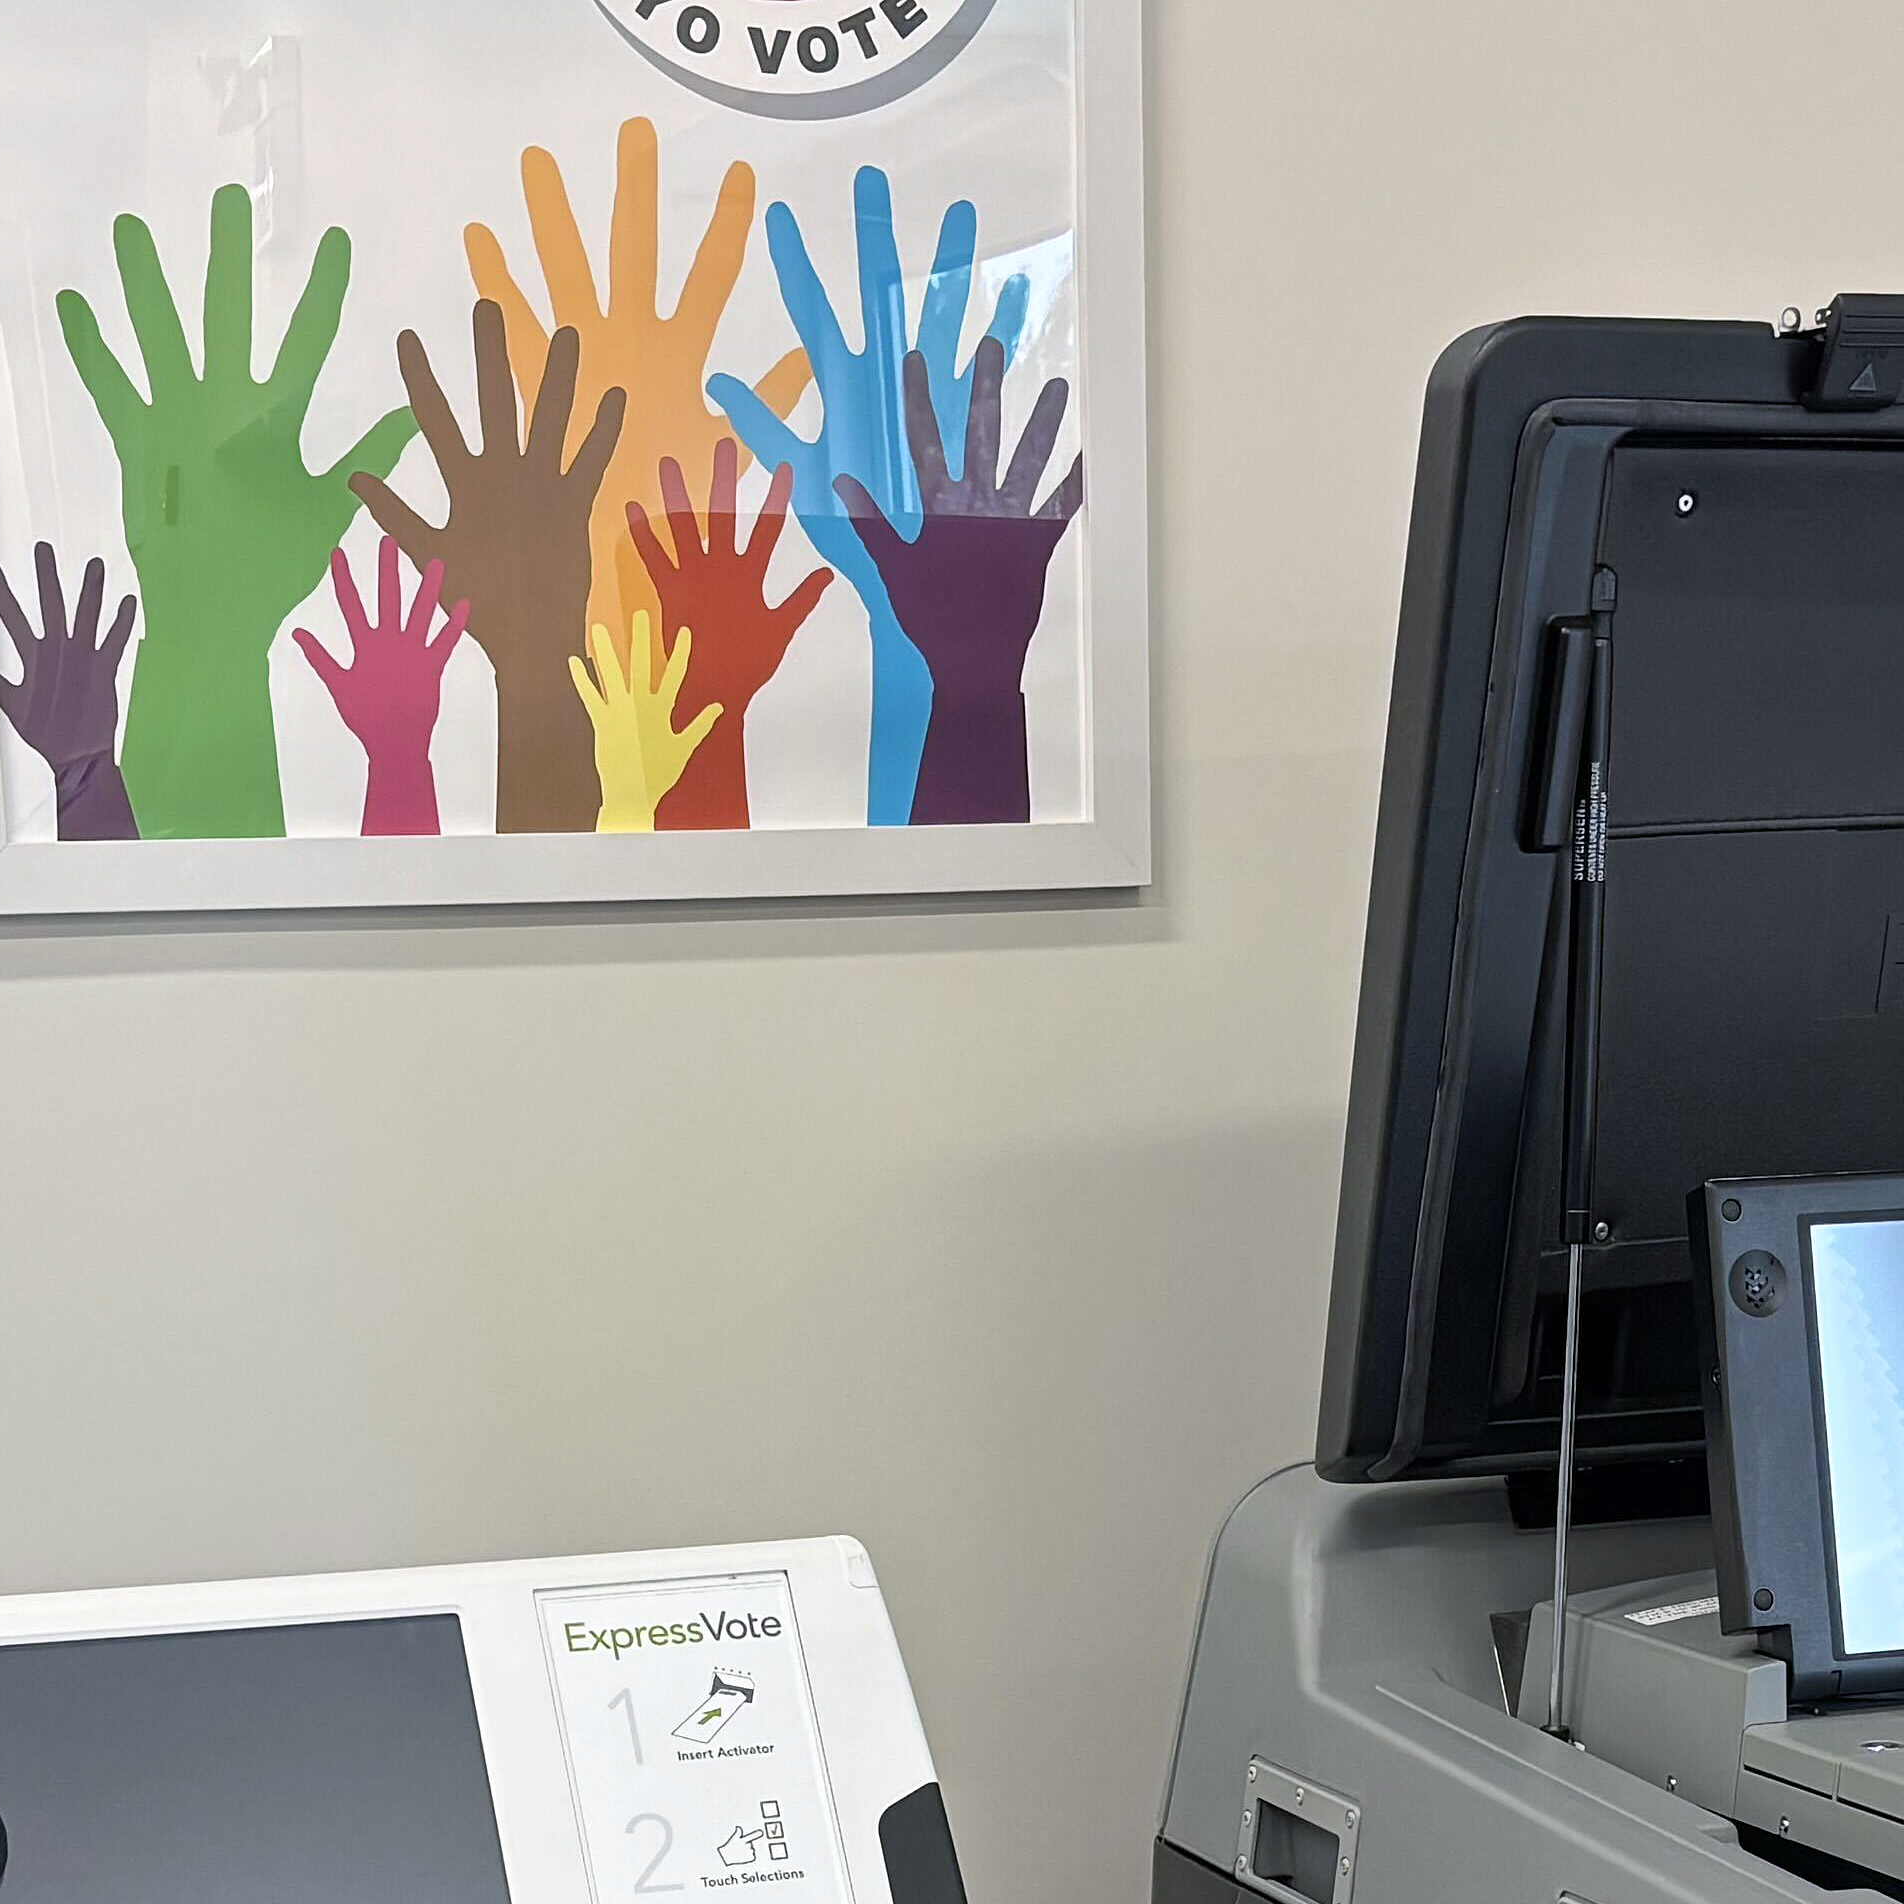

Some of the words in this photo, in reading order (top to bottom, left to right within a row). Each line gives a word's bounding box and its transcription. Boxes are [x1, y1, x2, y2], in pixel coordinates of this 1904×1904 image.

[564, 1611, 781, 1661] ExpressVote
[608, 1687, 644, 1766] 1
[677, 1750, 713, 1761] Insert
[717, 1744, 775, 1759] Activator
[624, 1812, 685, 1894] 2
[700, 1874, 739, 1888] Touch
[741, 1868, 805, 1884] Selections
